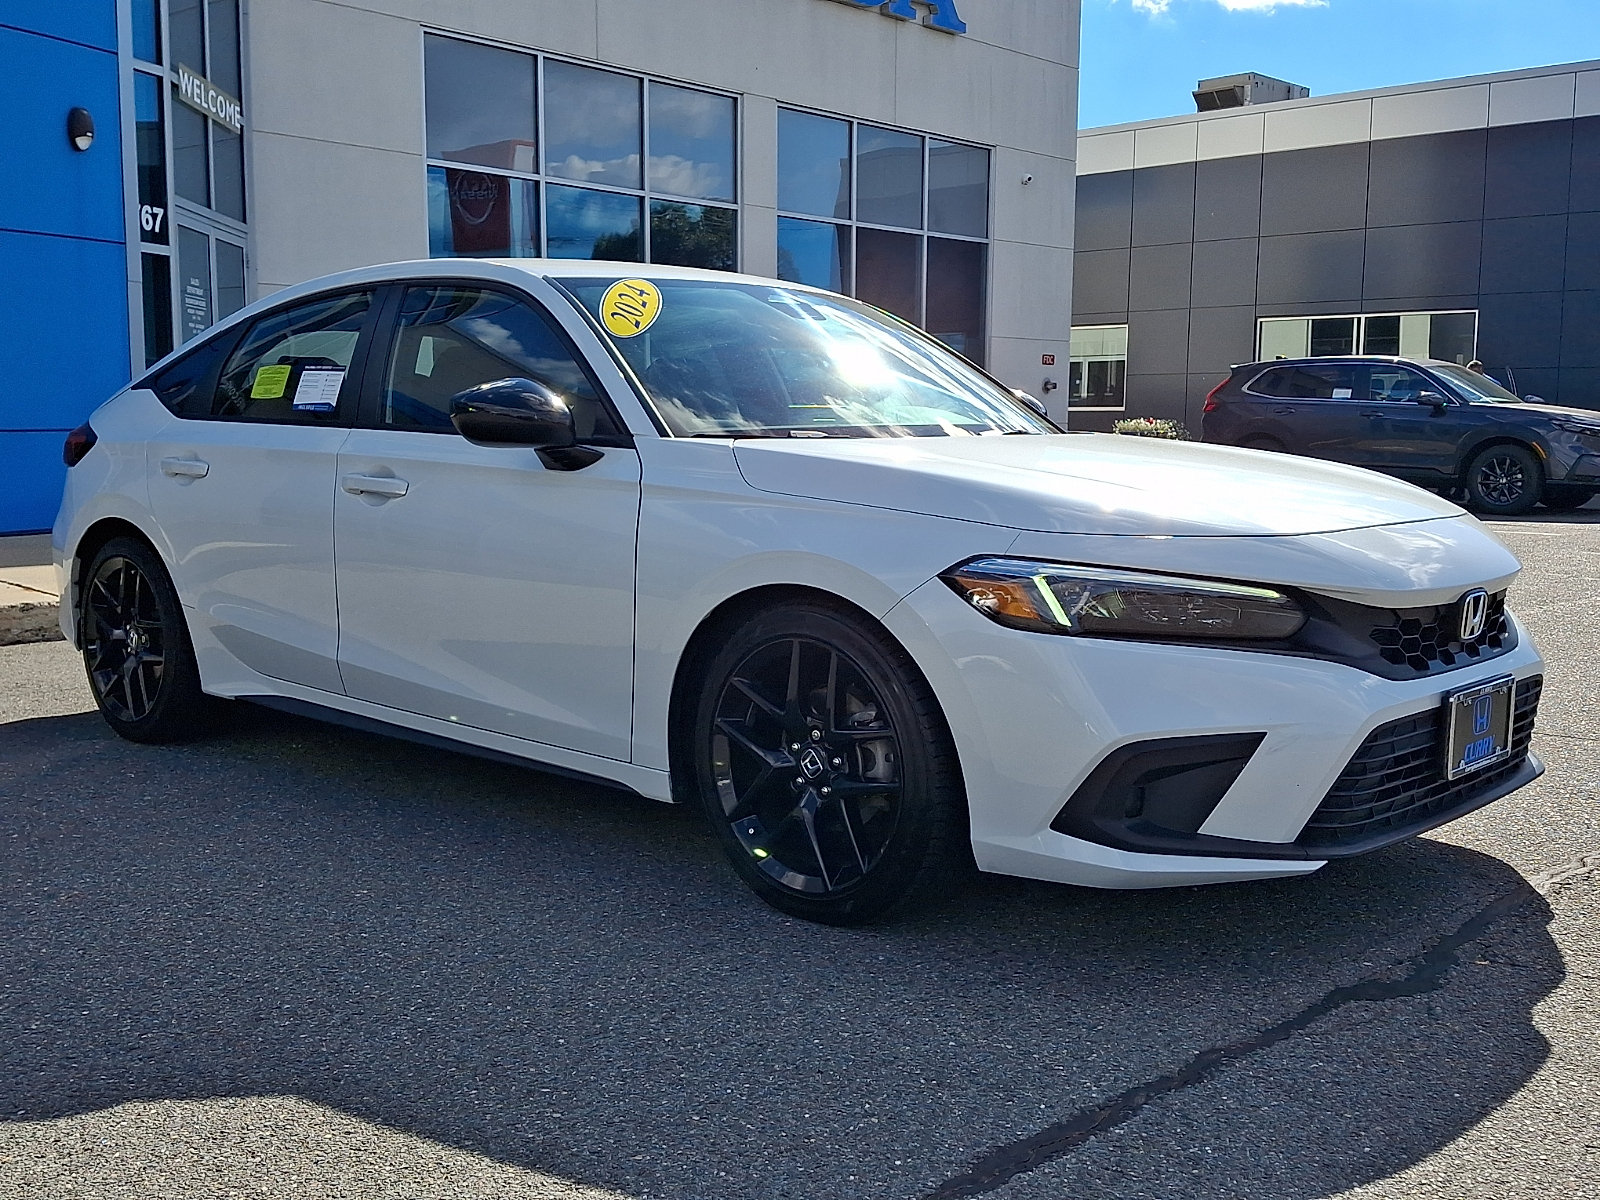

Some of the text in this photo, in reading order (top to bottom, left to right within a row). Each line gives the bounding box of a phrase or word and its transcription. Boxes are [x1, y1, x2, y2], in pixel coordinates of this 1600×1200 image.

[178, 68, 241, 129] WELCOME
[138, 203, 164, 233] 67
[610, 282, 651, 330] 2024
[1042, 355, 1055, 364] FDC
[1464, 734, 1496, 763] CURRY
